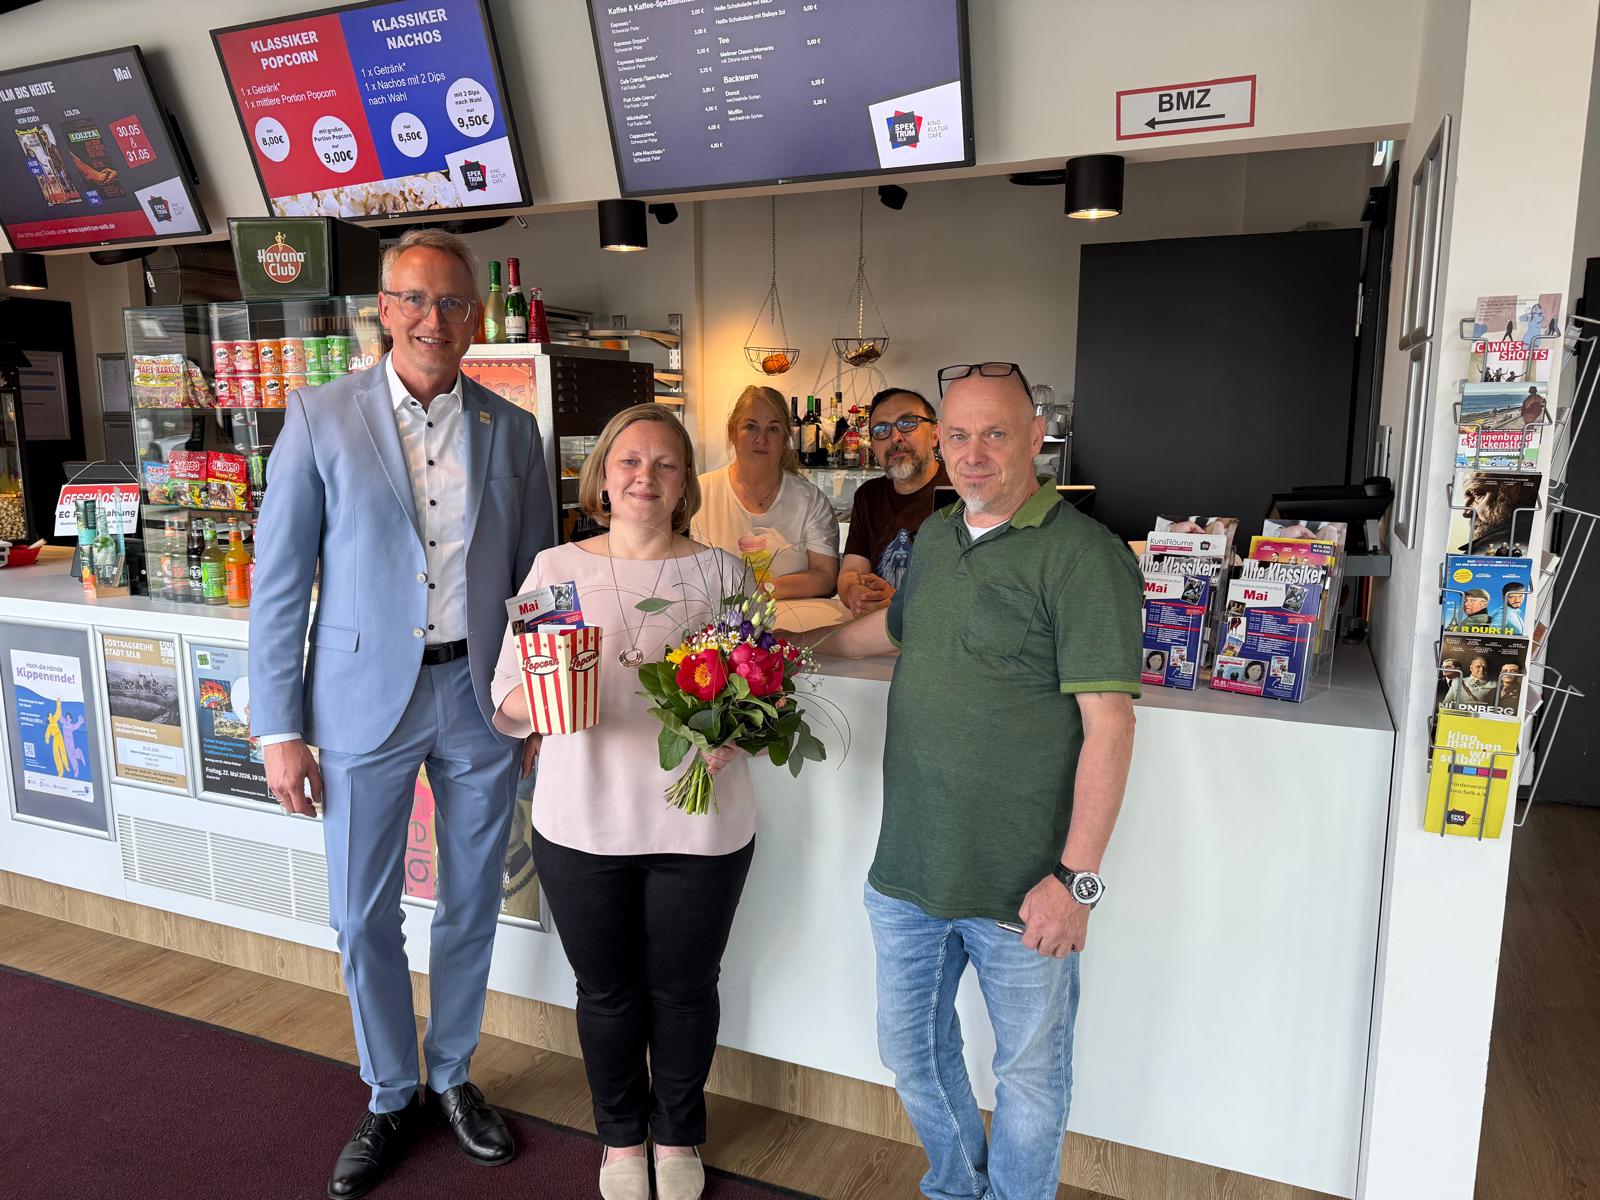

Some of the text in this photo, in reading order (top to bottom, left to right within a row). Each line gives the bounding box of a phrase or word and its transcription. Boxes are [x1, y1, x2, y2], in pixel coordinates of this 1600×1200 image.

[608, 7, 627, 15] Kaffee
[727, 1, 752, 10] Schokolade
[372, 8, 448, 32] KLASSIKER
[716, 17, 728, 25] Heiße
[729, 14, 754, 23] Schokolade
[762, 11, 778, 19] Baileys
[251, 31, 318, 53] KLASSIKER
[386, 29, 442, 49] NACHOS
[753, 45, 775, 53] Moments
[261, 50, 318, 70] POPCORN
[113, 67, 132, 82] Mai
[361, 69, 365, 77] 1
[723, 73, 759, 84] Backwaren
[365, 83, 370, 92] 1
[377, 77, 406, 90] Nachos
[407, 76, 420, 85] mit
[420, 73, 426, 84] 2
[427, 71, 446, 84] Dips
[14, 84, 30, 99] BIS
[28, 81, 56, 97] HEUTE
[241, 88, 246, 97] 1
[468, 89, 480, 97] Dips
[245, 100, 250, 109] 1
[256, 97, 280, 108] mittlere
[281, 92, 306, 105] Portion
[306, 88, 337, 102] Popcorn
[368, 91, 408, 106] nach Wahl
[1158, 88, 1211, 113] BMZ
[15, 106, 35, 115] JENSEITS
[64, 108, 80, 117] LOLITA
[17, 115, 40, 124] VON EDEN
[457, 114, 489, 129] 9,50€
[116, 124, 140, 138] 30.05
[327, 127, 343, 136] großer
[894, 122, 915, 131] SPEK
[70, 131, 98, 141] LOLITA
[332, 133, 353, 142] Popcorn
[398, 131, 423, 144] 8,50€
[894, 130, 916, 138] TRUM
[129, 138, 138, 148] &
[262, 135, 285, 148] 8,00€
[126, 149, 150, 163] 31.05
[324, 150, 354, 165] 9,00€
[468, 176, 484, 184] TRUM
[257, 249, 305, 263] Havana
[268, 263, 296, 276] Club
[211, 460, 240, 473] HARIBO
[1241, 558, 1327, 584] Alte Klassiker
[1144, 582, 1168, 594] Mai
[1243, 589, 1269, 601] Mai
[518, 600, 539, 615] Mai
[104, 638, 154, 653] VORTRAGSREIHE
[105, 648, 141, 659] STADT SELB
[522, 655, 560, 672] Popcorn
[568, 649, 600, 672] Popcorn
[16, 667, 76, 684] Kippenende!
[48, 665, 63, 673] Hände
[1448, 731, 1478, 742] kino
[1447, 740, 1502, 752] machen
[206, 767, 222, 775] Freitag,
[239, 772, 252, 781] 2026,
[1463, 789, 1476, 797] Selb
